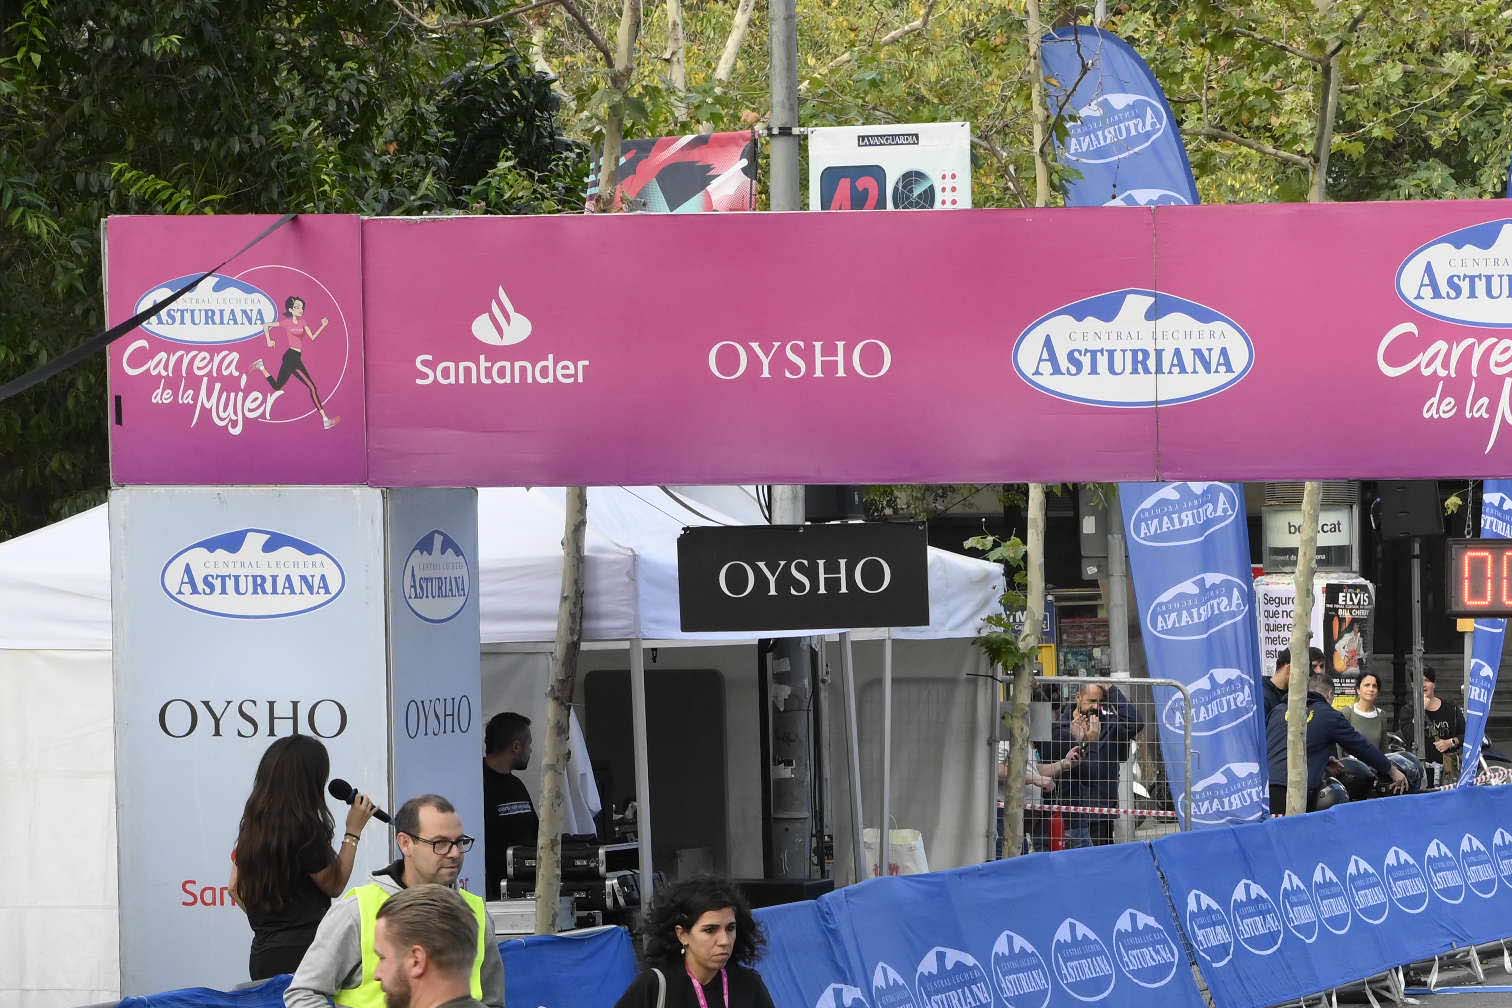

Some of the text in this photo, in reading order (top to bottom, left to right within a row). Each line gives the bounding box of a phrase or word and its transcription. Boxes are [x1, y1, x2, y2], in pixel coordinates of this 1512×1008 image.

[148, 299, 266, 326] ASTURIANA
[1068, 329, 1228, 342] CENTRAL LECHERA
[122, 339, 241, 376] Carrera
[415, 354, 589, 385] Santander
[708, 338, 892, 380] OYSHO
[1032, 333, 1236, 378] ASTURIANA
[151, 373, 285, 436] de la Mujer
[1422, 381, 1457, 420] de
[1466, 379, 1490, 420] la
[1288, 520, 1342, 535] b.cat
[176, 562, 332, 597] ASTURIANA
[203, 560, 261, 569] CENTRAL
[408, 564, 466, 600] ASTURIANA
[718, 556, 893, 598] OYSHO
[1338, 592, 1369, 606] ELVIS
[1264, 623, 1296, 633] quiere
[158, 698, 348, 739] OYSHO
[405, 694, 472, 739] OYSHO
[181, 879, 237, 907] San
[1058, 953, 1113, 984] ASTURIANA
